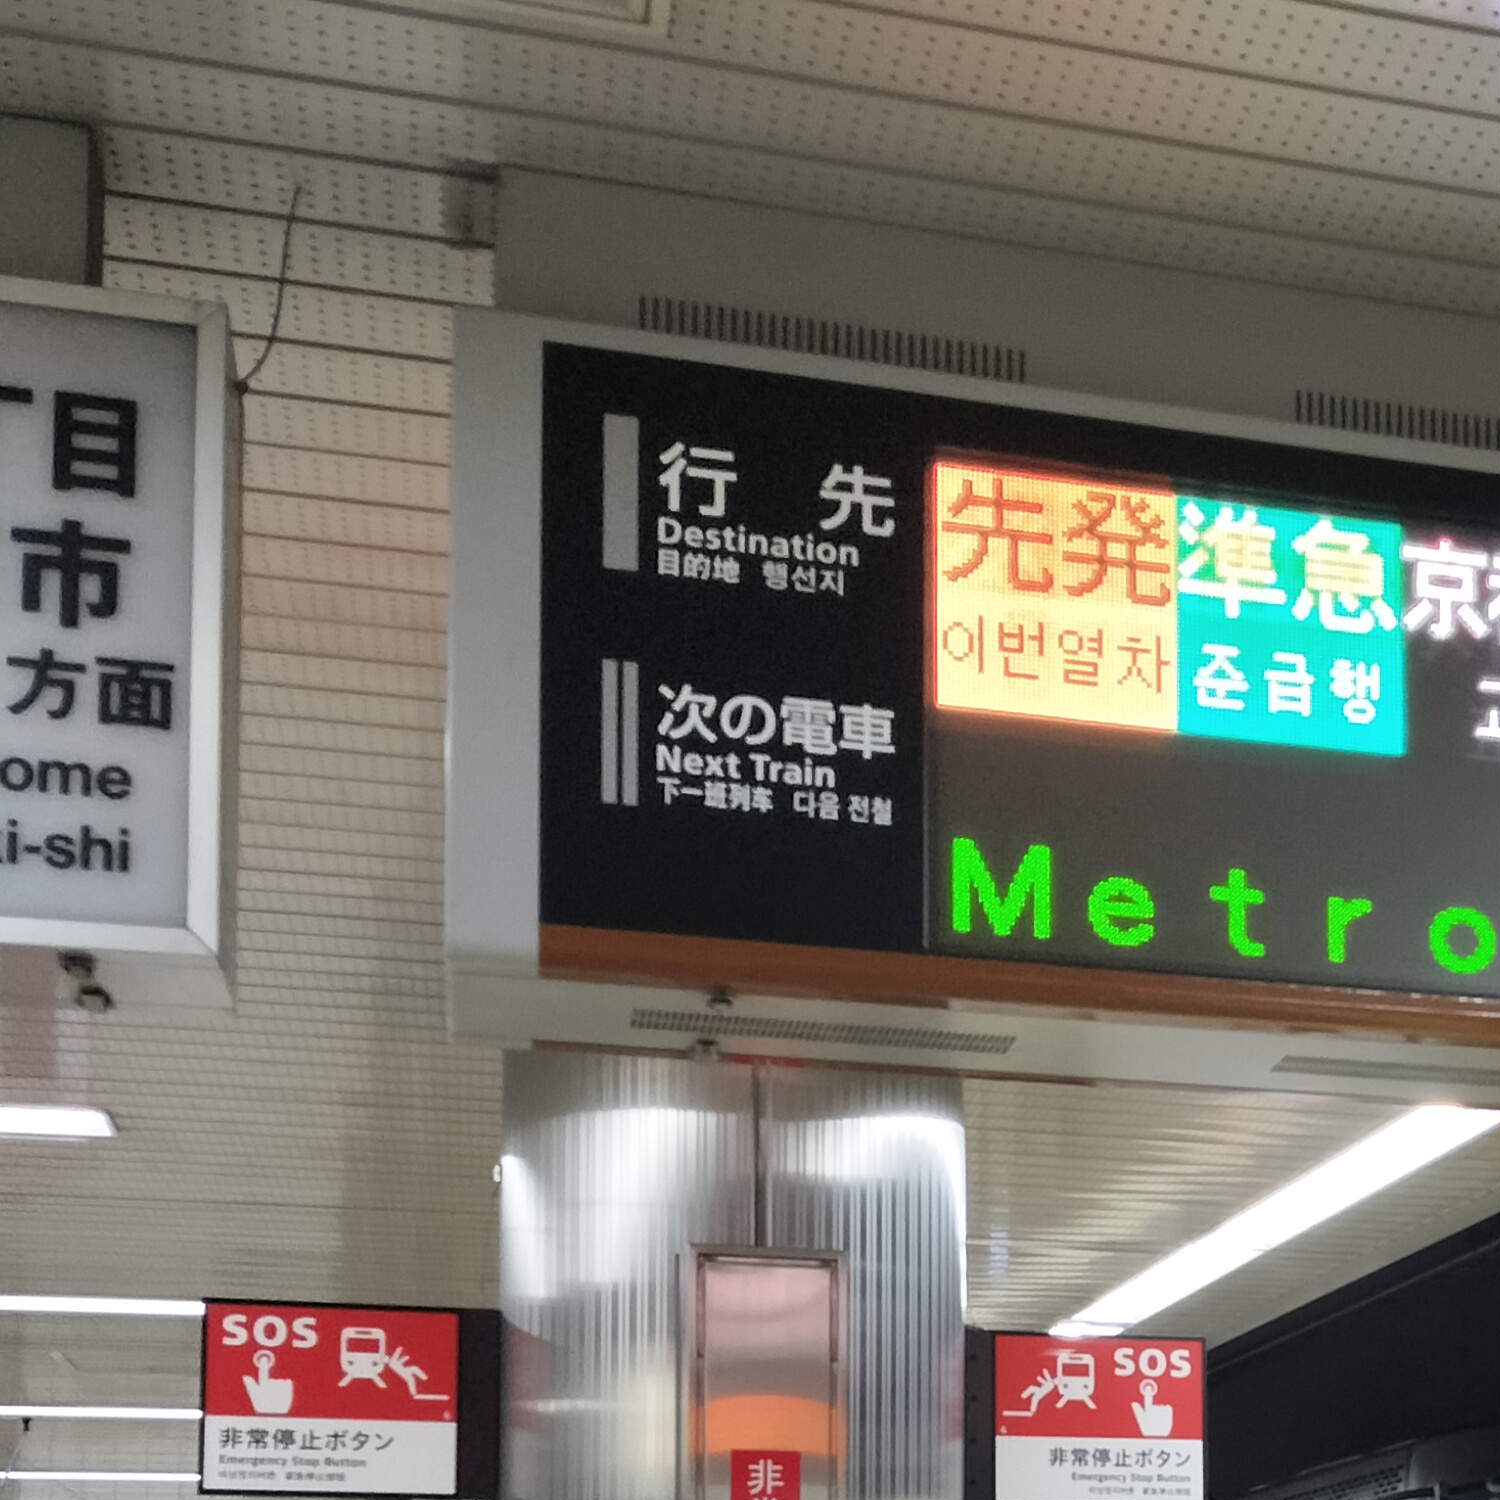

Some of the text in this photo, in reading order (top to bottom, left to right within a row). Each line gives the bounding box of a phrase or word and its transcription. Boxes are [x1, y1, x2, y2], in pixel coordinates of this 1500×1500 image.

[657, 515, 860, 567] Destination
[941, 477, 1172, 607] 先発
[656, 548, 741, 585] 目的地
[1177, 501, 1398, 634] 準急
[6, 647, 175, 731] 方面
[656, 683, 896, 760] 次の電車
[655, 743, 837, 790] Next Train
[0, 818, 131, 874] i-shi
[221, 1313, 319, 1349] SOS
[1113, 1346, 1192, 1379] SOS
[219, 1427, 395, 1452] 非常停止ボタン
[1049, 1447, 1191, 1469] 非常停止ボタン
